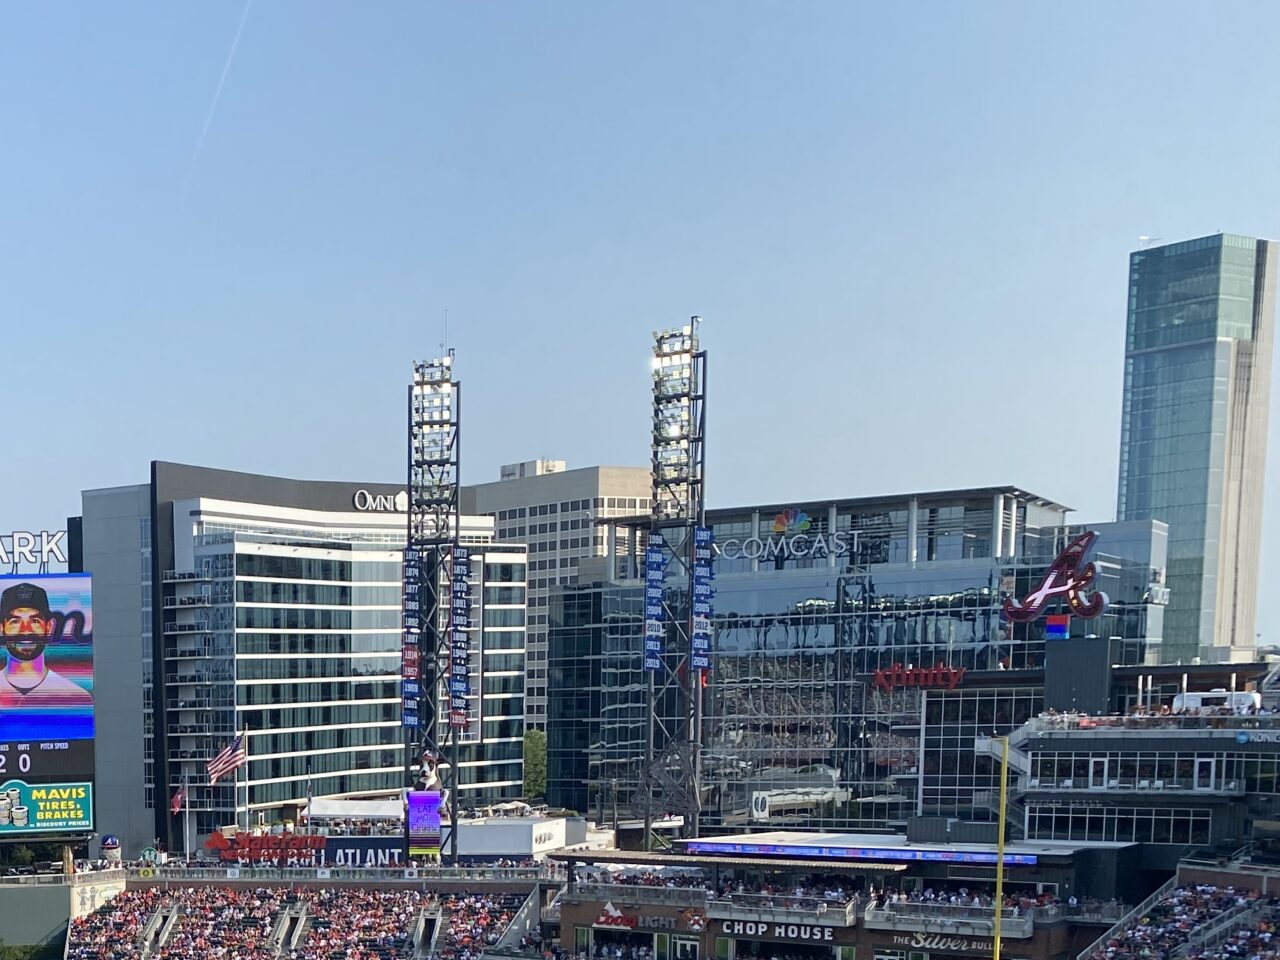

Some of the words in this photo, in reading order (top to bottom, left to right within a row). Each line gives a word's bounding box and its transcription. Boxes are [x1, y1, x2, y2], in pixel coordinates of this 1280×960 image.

[696, 531, 710, 540] 1997
[722, 530, 863, 560] COMCAST
[646, 624, 660, 633] 2010
[694, 621, 709, 630] 2012
[404, 651, 417, 660] 1914
[646, 659, 659, 668] 2019
[693, 657, 708, 666] 2020
[404, 667, 417, 676] 1957
[874, 662, 966, 694] xfinity
[18, 753, 31, 773] 0
[32, 787, 86, 800] MAVIS
[37, 801, 75, 810] TIRES
[36, 810, 84, 820] BRAKES
[637, 915, 677, 929] LIGHT
[722, 920, 768, 936] CHOP
[775, 922, 834, 941] HOUSE
[892, 935, 910, 946] THE
[911, 932, 970, 951] Silver
